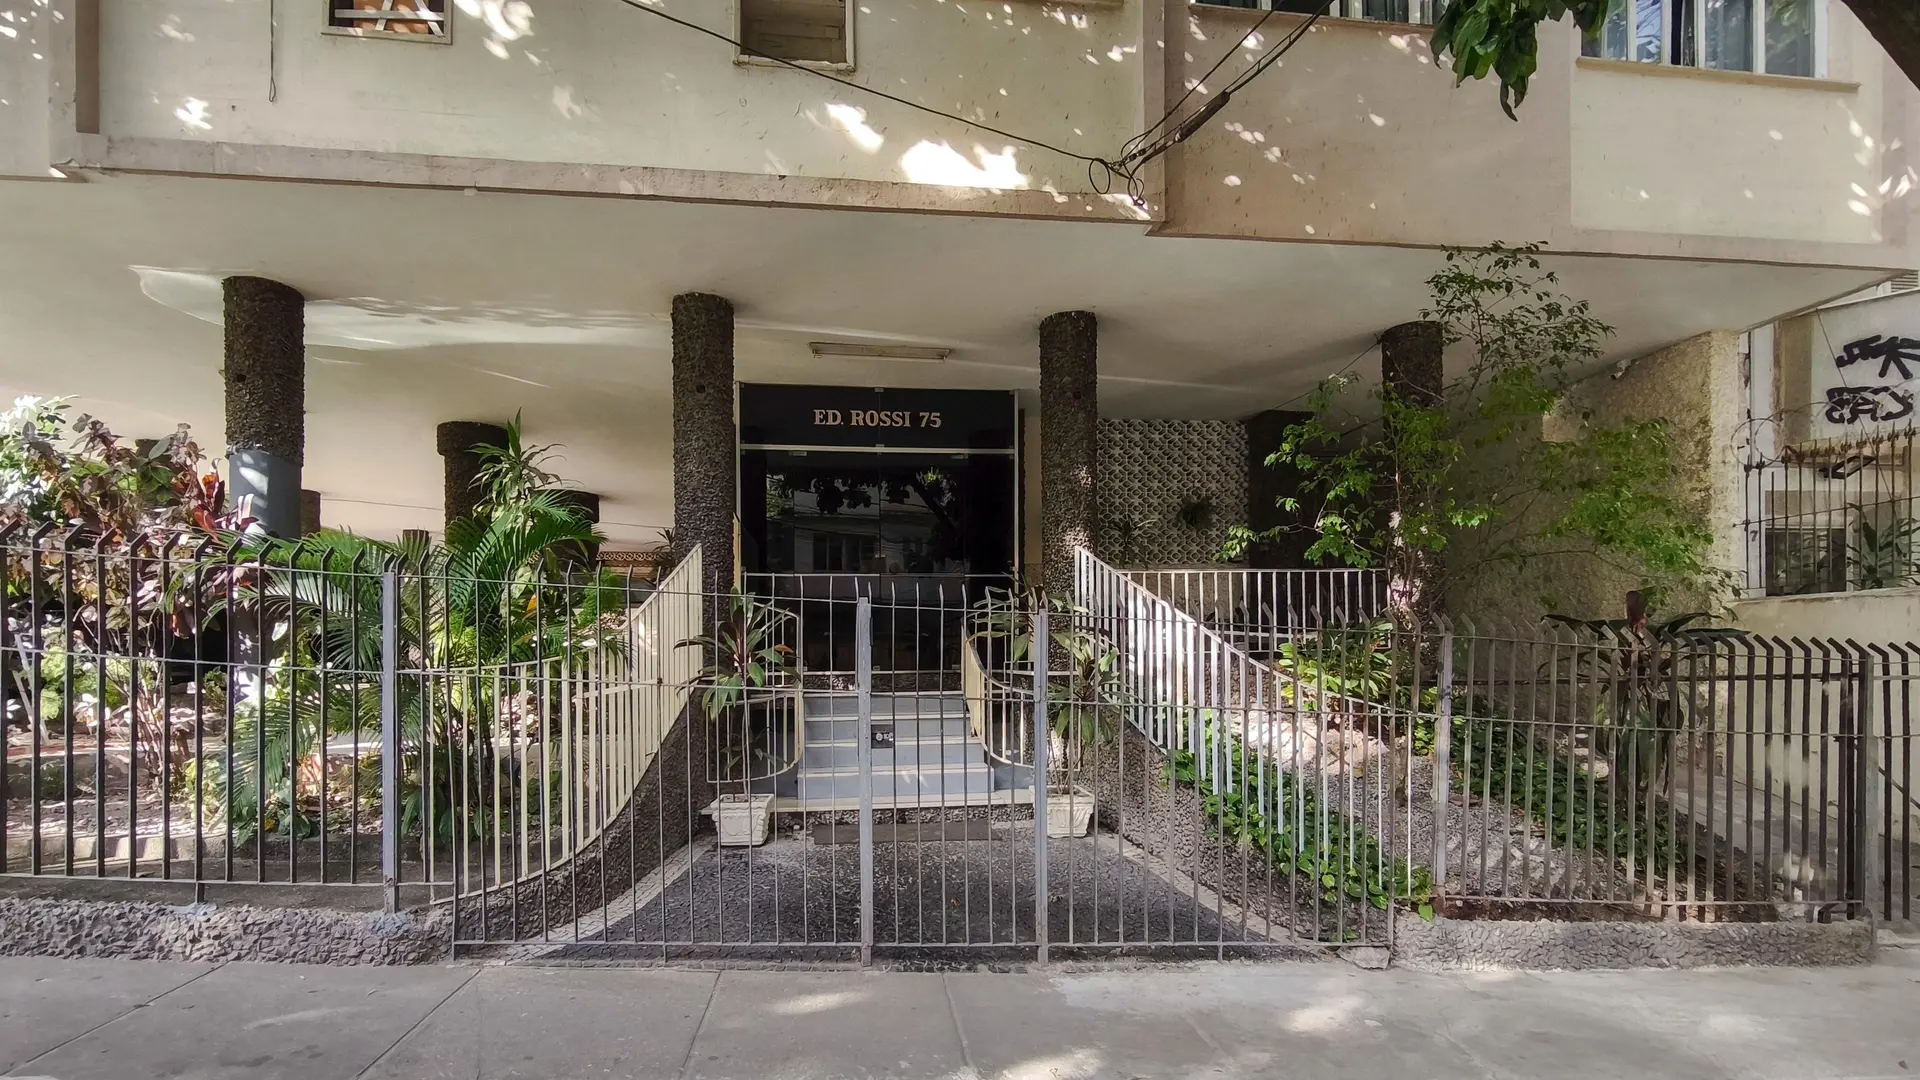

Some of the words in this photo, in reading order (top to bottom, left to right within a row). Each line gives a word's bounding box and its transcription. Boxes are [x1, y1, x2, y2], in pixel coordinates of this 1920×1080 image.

[813, 409, 844, 426] ED.
[849, 410, 912, 427] ROSSI
[919, 412, 942, 428] 75
